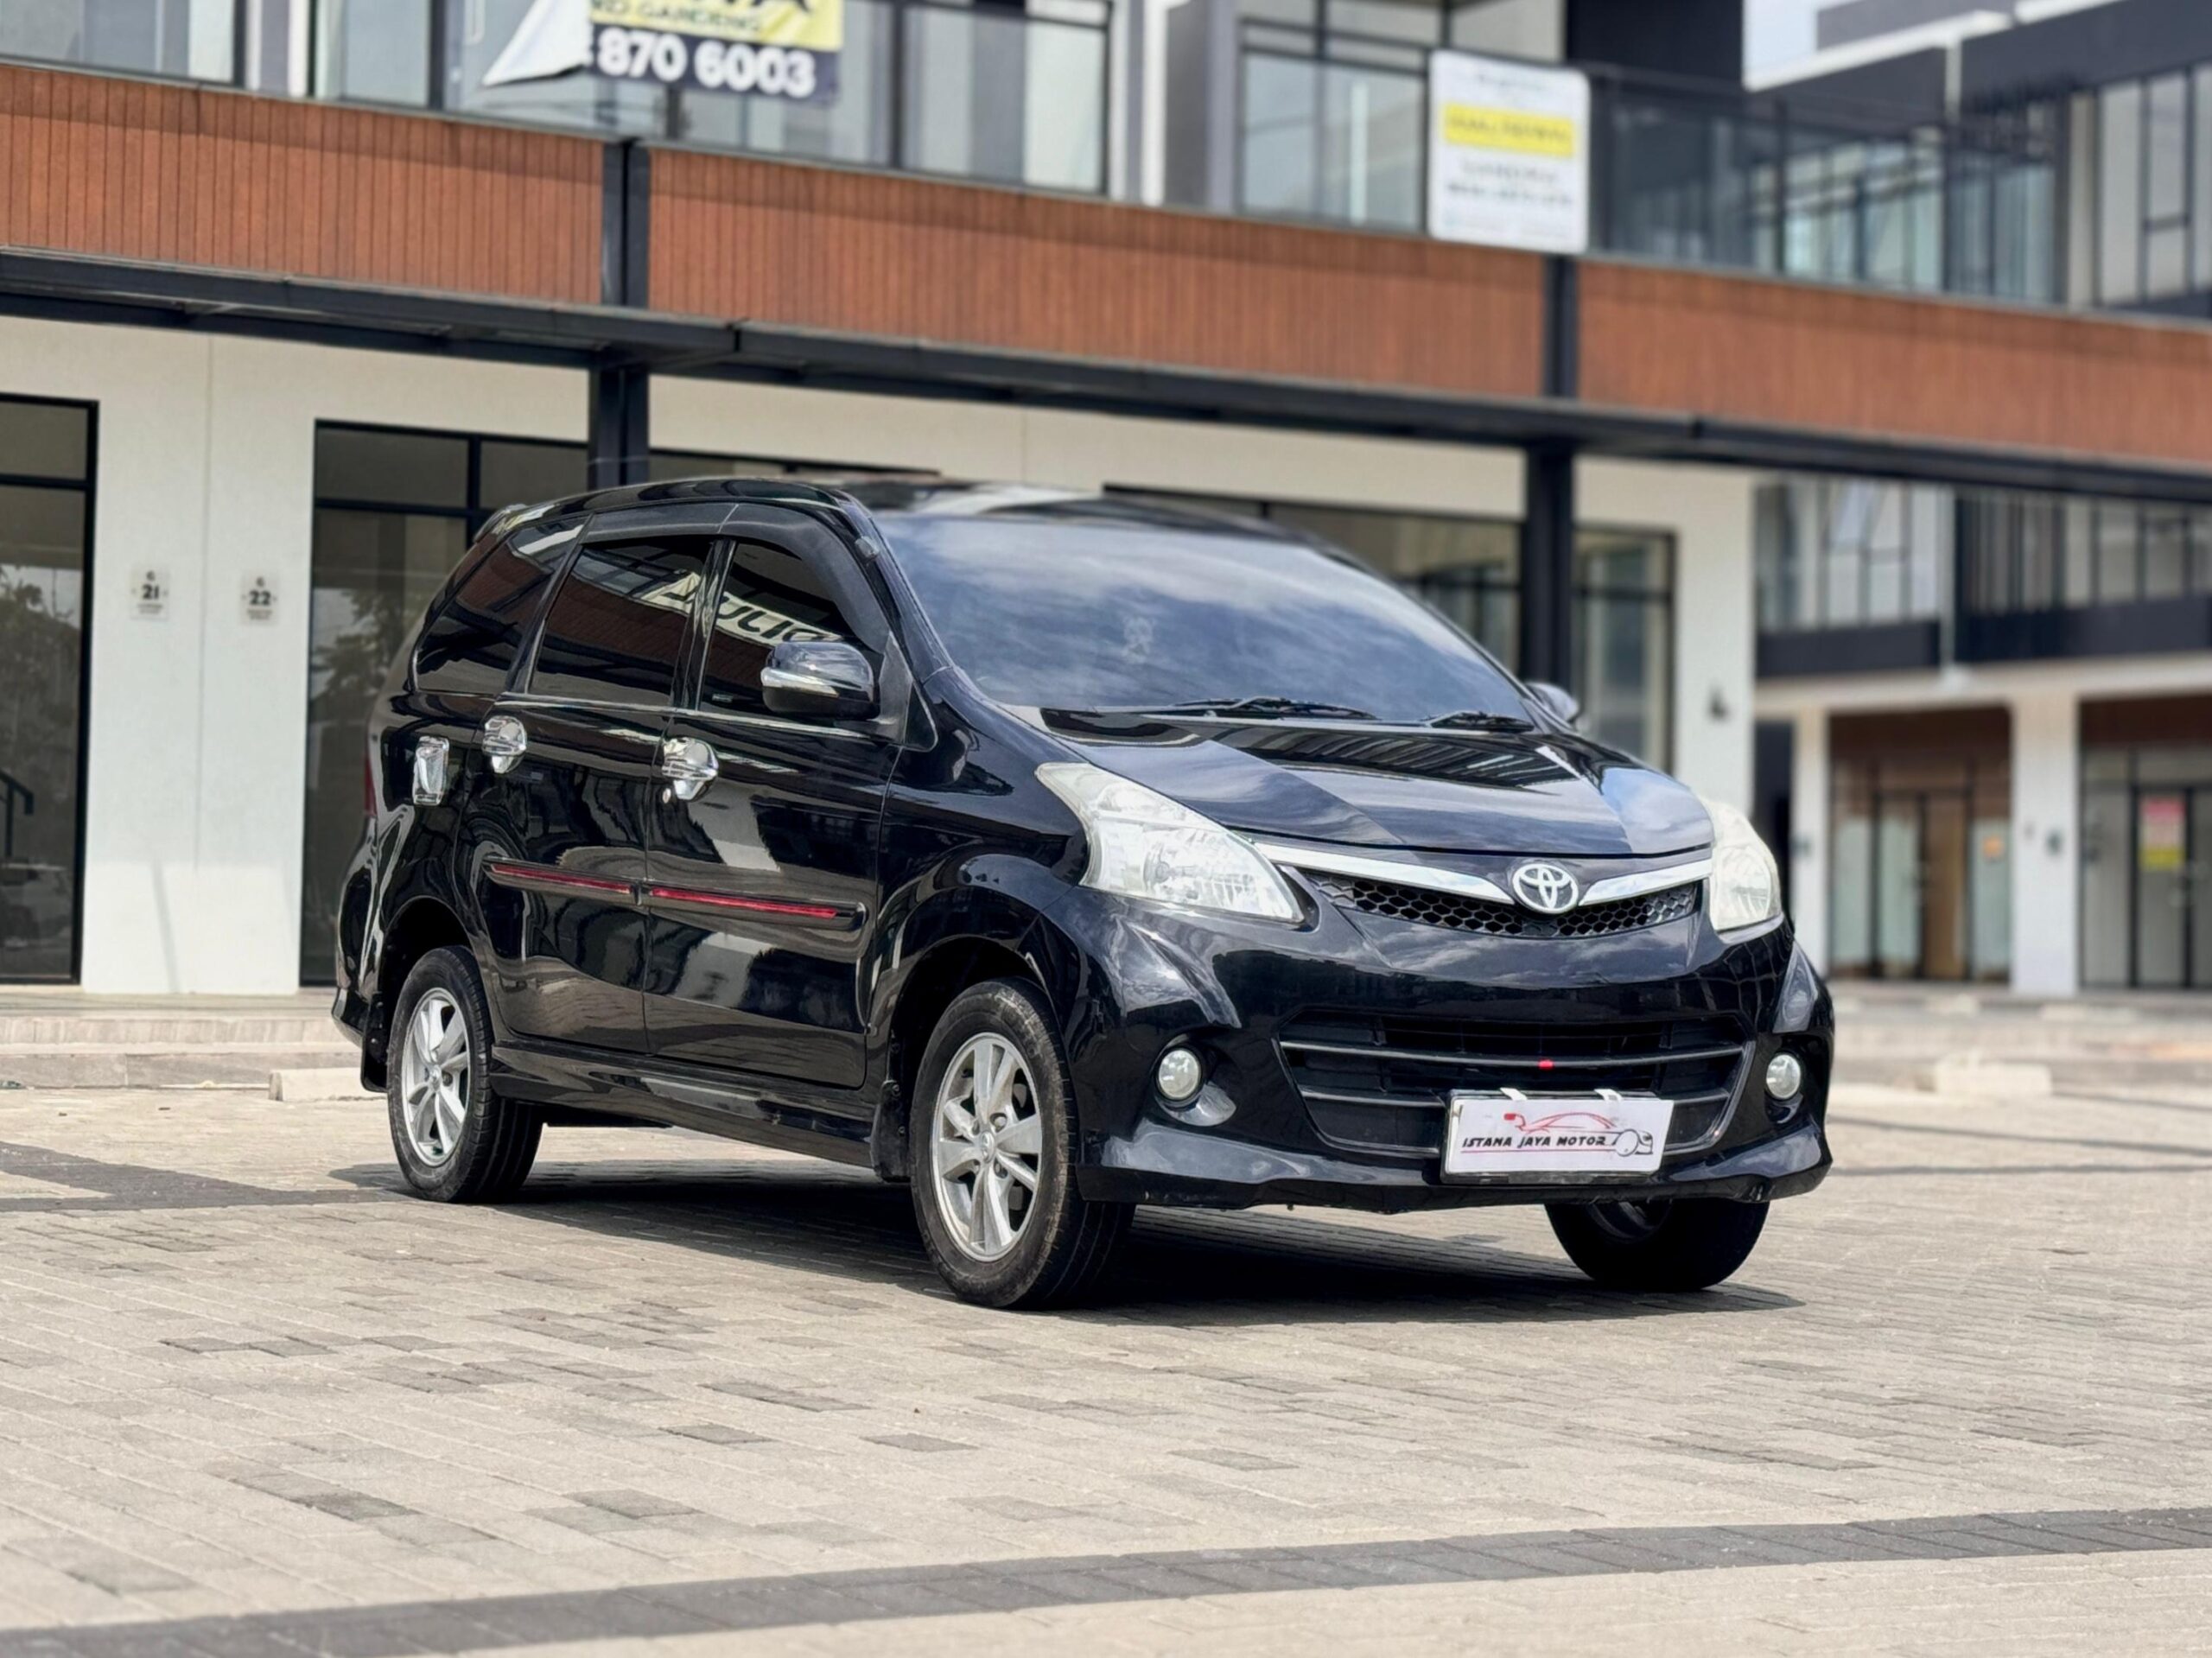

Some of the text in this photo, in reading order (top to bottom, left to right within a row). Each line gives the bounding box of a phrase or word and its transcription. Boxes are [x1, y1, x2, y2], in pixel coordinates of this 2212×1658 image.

[598, 28, 815, 98] 870 6003
[143, 584, 160, 600] 21
[250, 590, 271, 606] 22
[1463, 1136, 1606, 1148] ISTANA JAYA MOTOR
